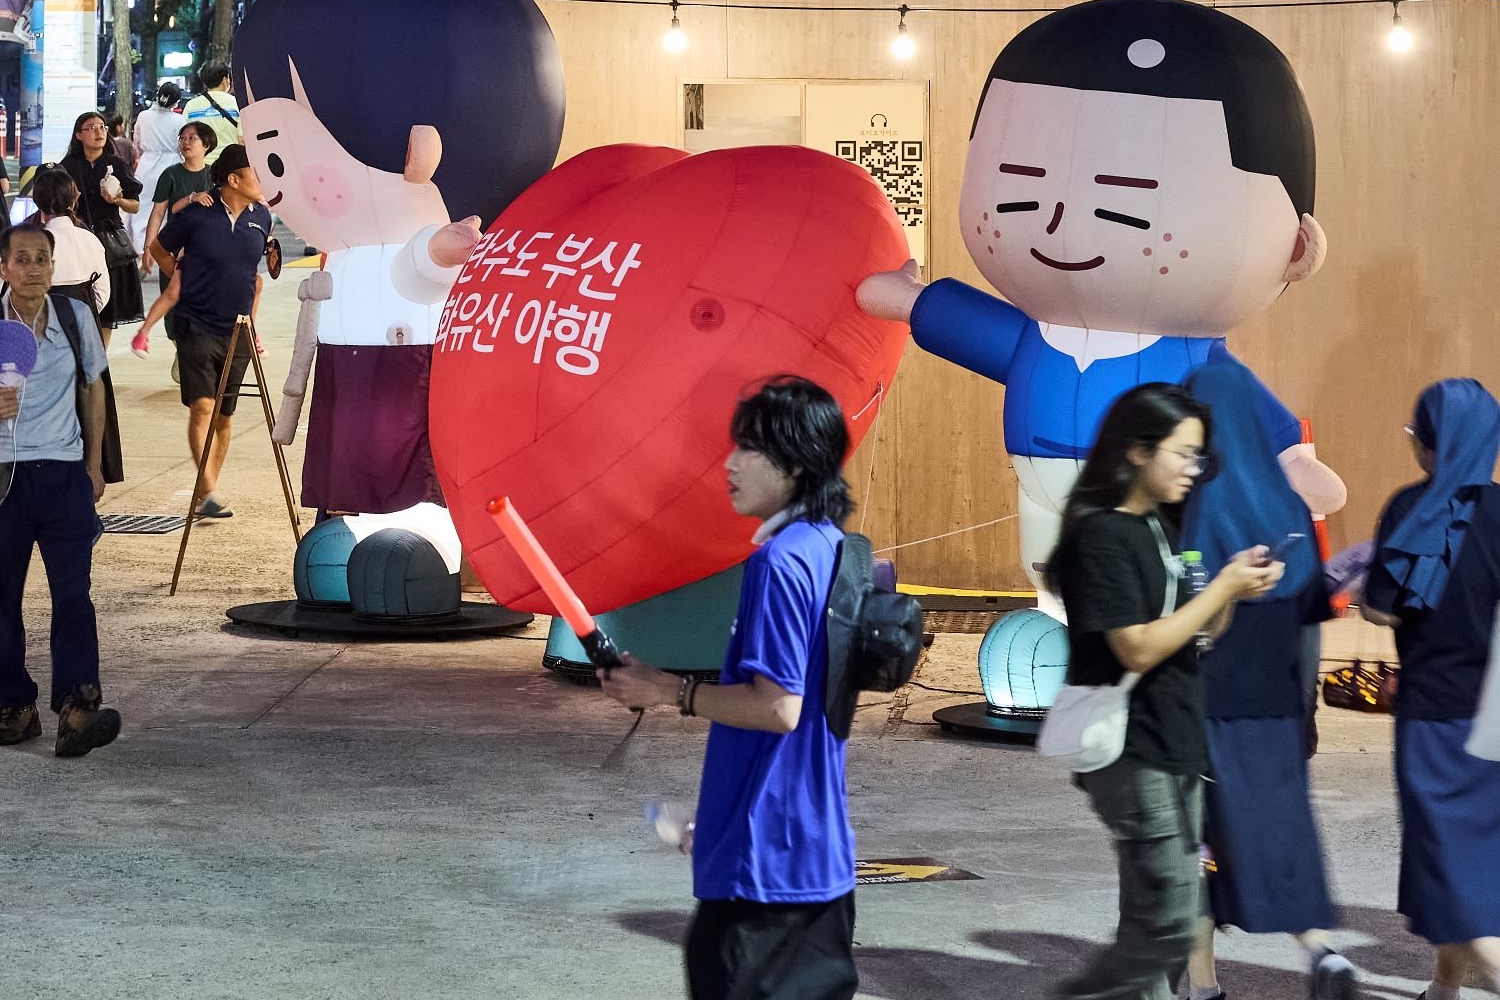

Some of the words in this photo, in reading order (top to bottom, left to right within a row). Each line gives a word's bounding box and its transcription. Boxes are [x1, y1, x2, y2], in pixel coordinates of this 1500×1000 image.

[860, 129, 899, 137] 오디오가이드
[457, 228, 555, 284] 란수도
[541, 233, 642, 301] 부산
[435, 292, 514, 353] 화유산
[514, 299, 612, 376] 야행
